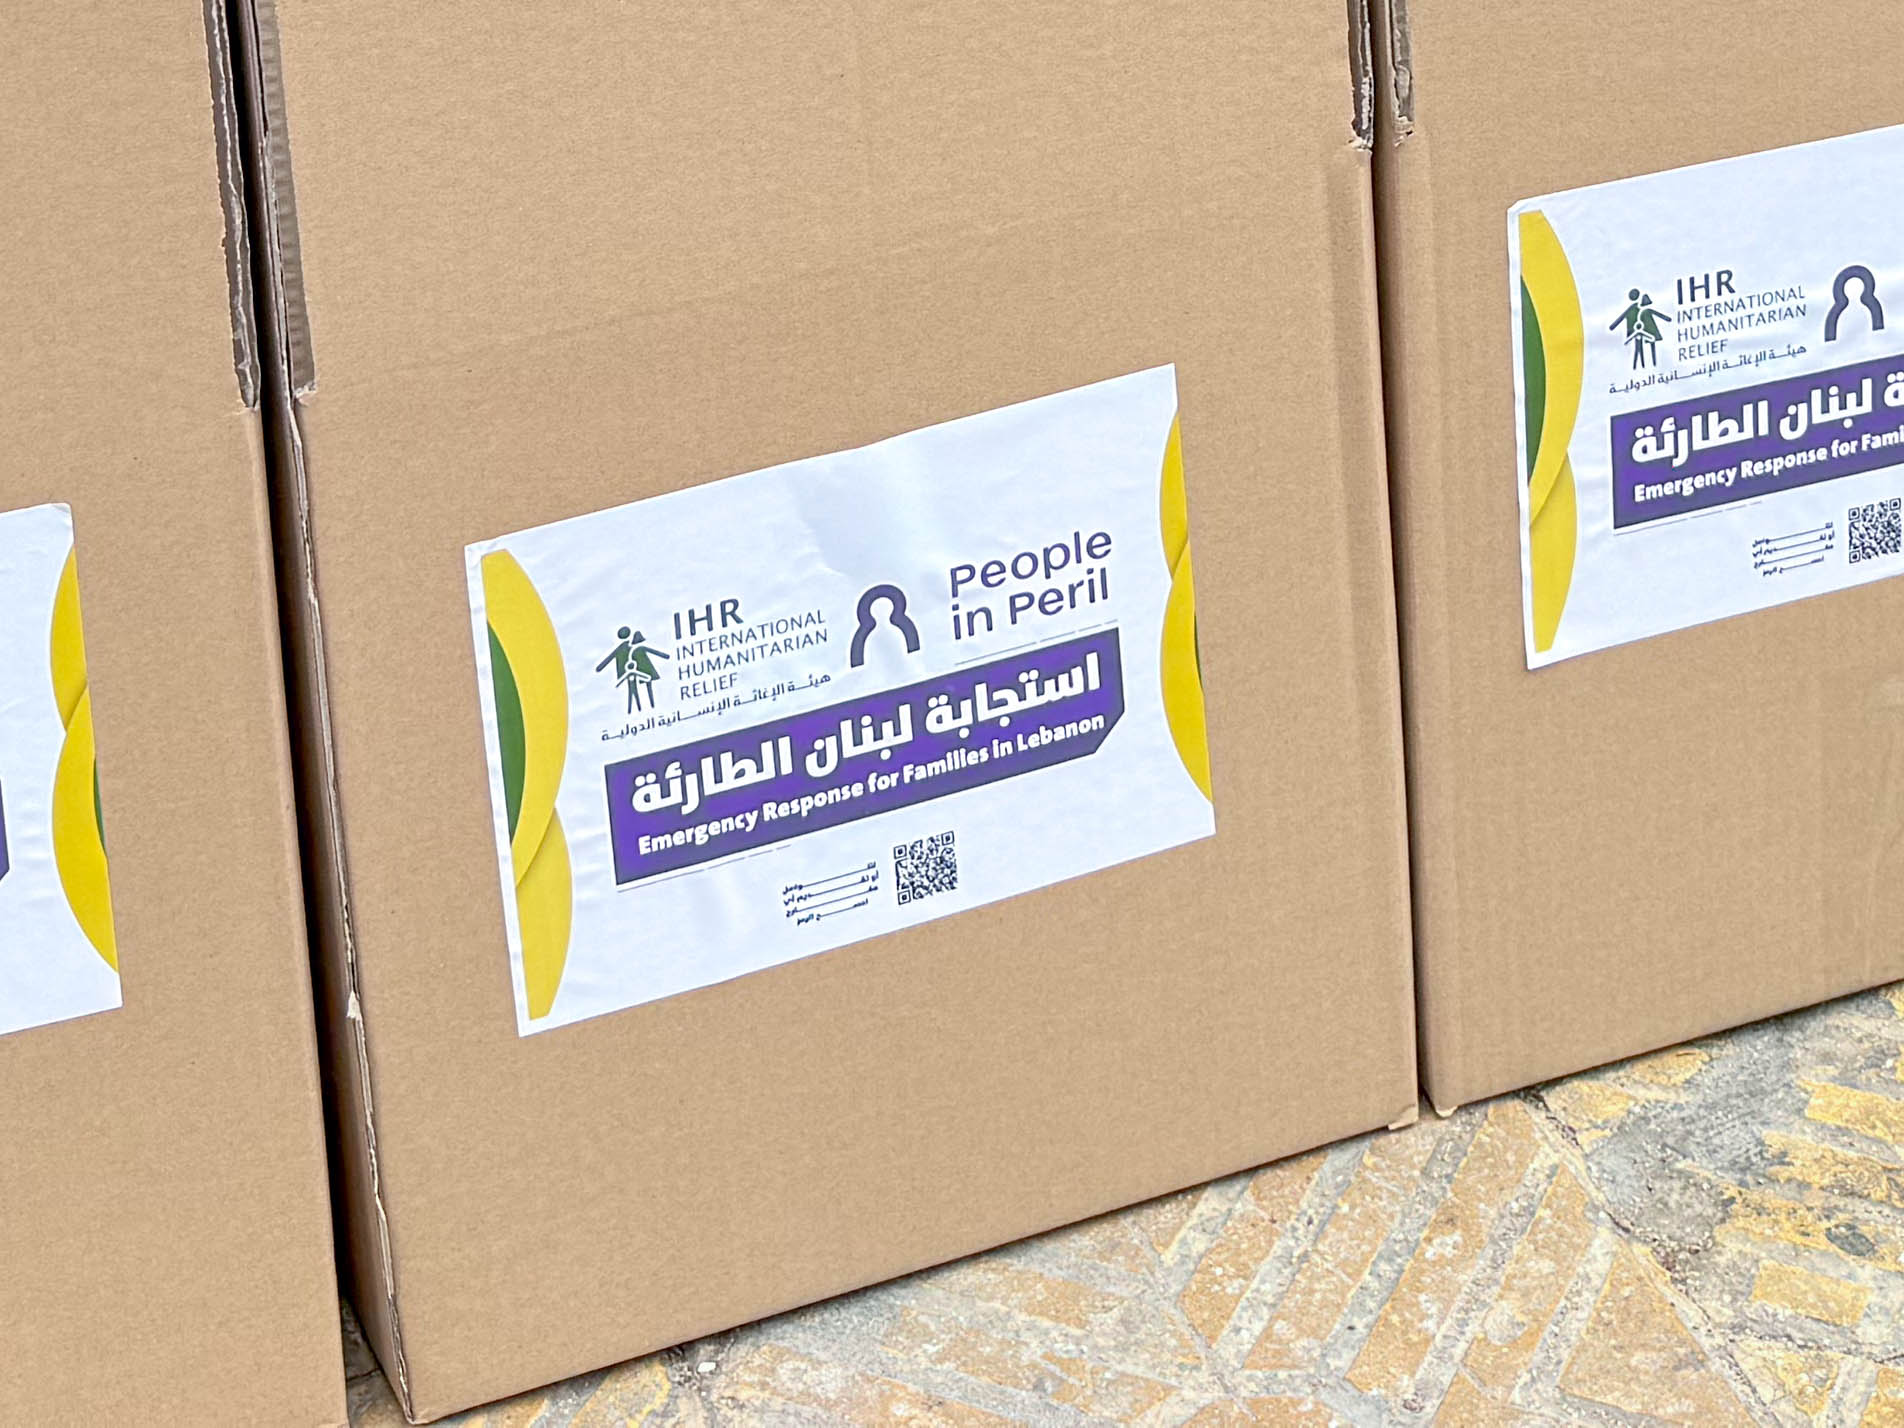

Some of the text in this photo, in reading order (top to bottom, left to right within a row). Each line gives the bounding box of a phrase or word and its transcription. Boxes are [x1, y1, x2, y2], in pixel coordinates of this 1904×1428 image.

[1676, 269, 1736, 306] IHR
[1677, 285, 1805, 324] INTERNATIONAL
[1677, 303, 1807, 343] HUMANITARIAN
[1678, 338, 1729, 362] RELIEF
[1631, 400, 1769, 468] الطارئة
[1779, 377, 1873, 441] لبنان
[1634, 466, 1738, 503] Emergency
[1740, 447, 1828, 479] Response
[1830, 439, 1859, 458] for
[950, 530, 1112, 599] People
[673, 598, 744, 641] IHR
[951, 567, 1109, 641] in Peril
[676, 609, 825, 661] INTERNATIONAL
[678, 628, 828, 681] HUMANITARIAN
[680, 672, 738, 701] RELIEF
[632, 651, 1100, 815] استجابة لبنان الطارئة
[638, 715, 1105, 855] Emergency Response for Families in Lebanon
